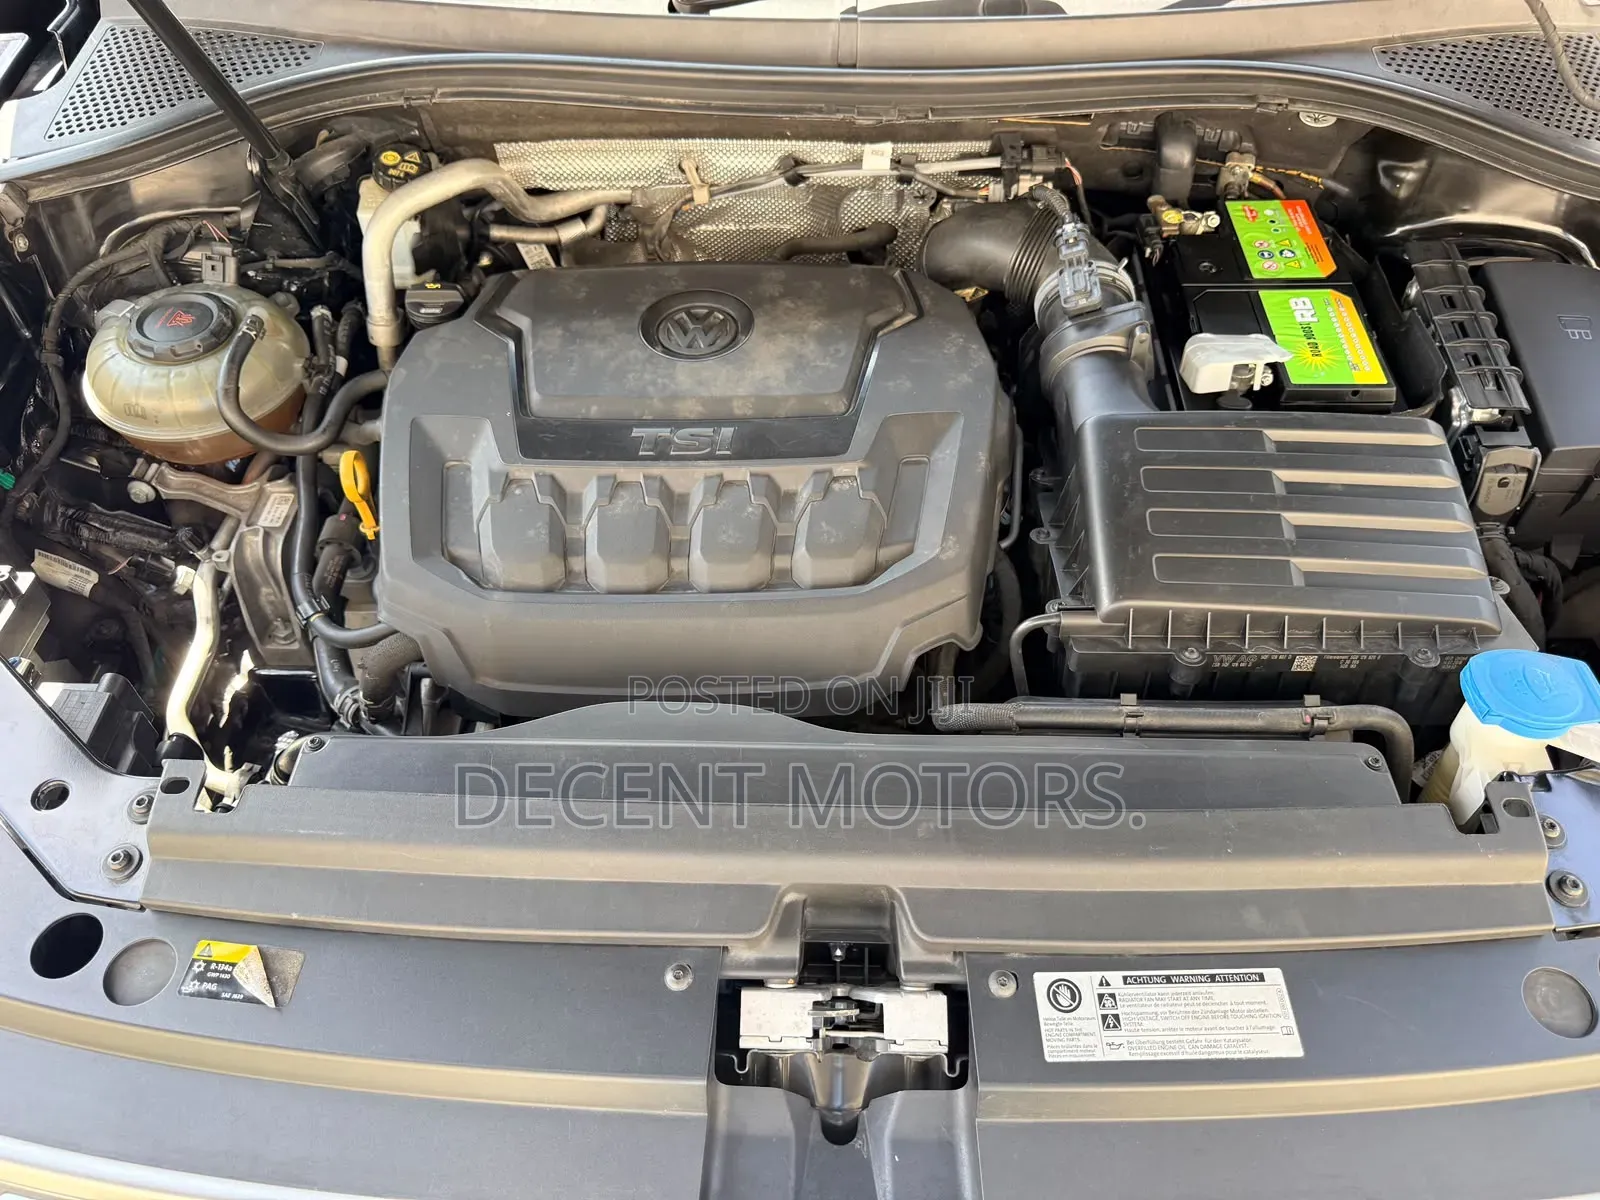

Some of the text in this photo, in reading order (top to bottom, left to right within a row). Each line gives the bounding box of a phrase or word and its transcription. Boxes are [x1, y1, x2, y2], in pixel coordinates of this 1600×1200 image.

[631, 426, 737, 456] TSI
[210, 962, 233, 972] R-134a
[1170, 975, 1210, 983] WARNING
[1215, 974, 1260, 982] ATTENTION
[202, 982, 218, 990] PAG
